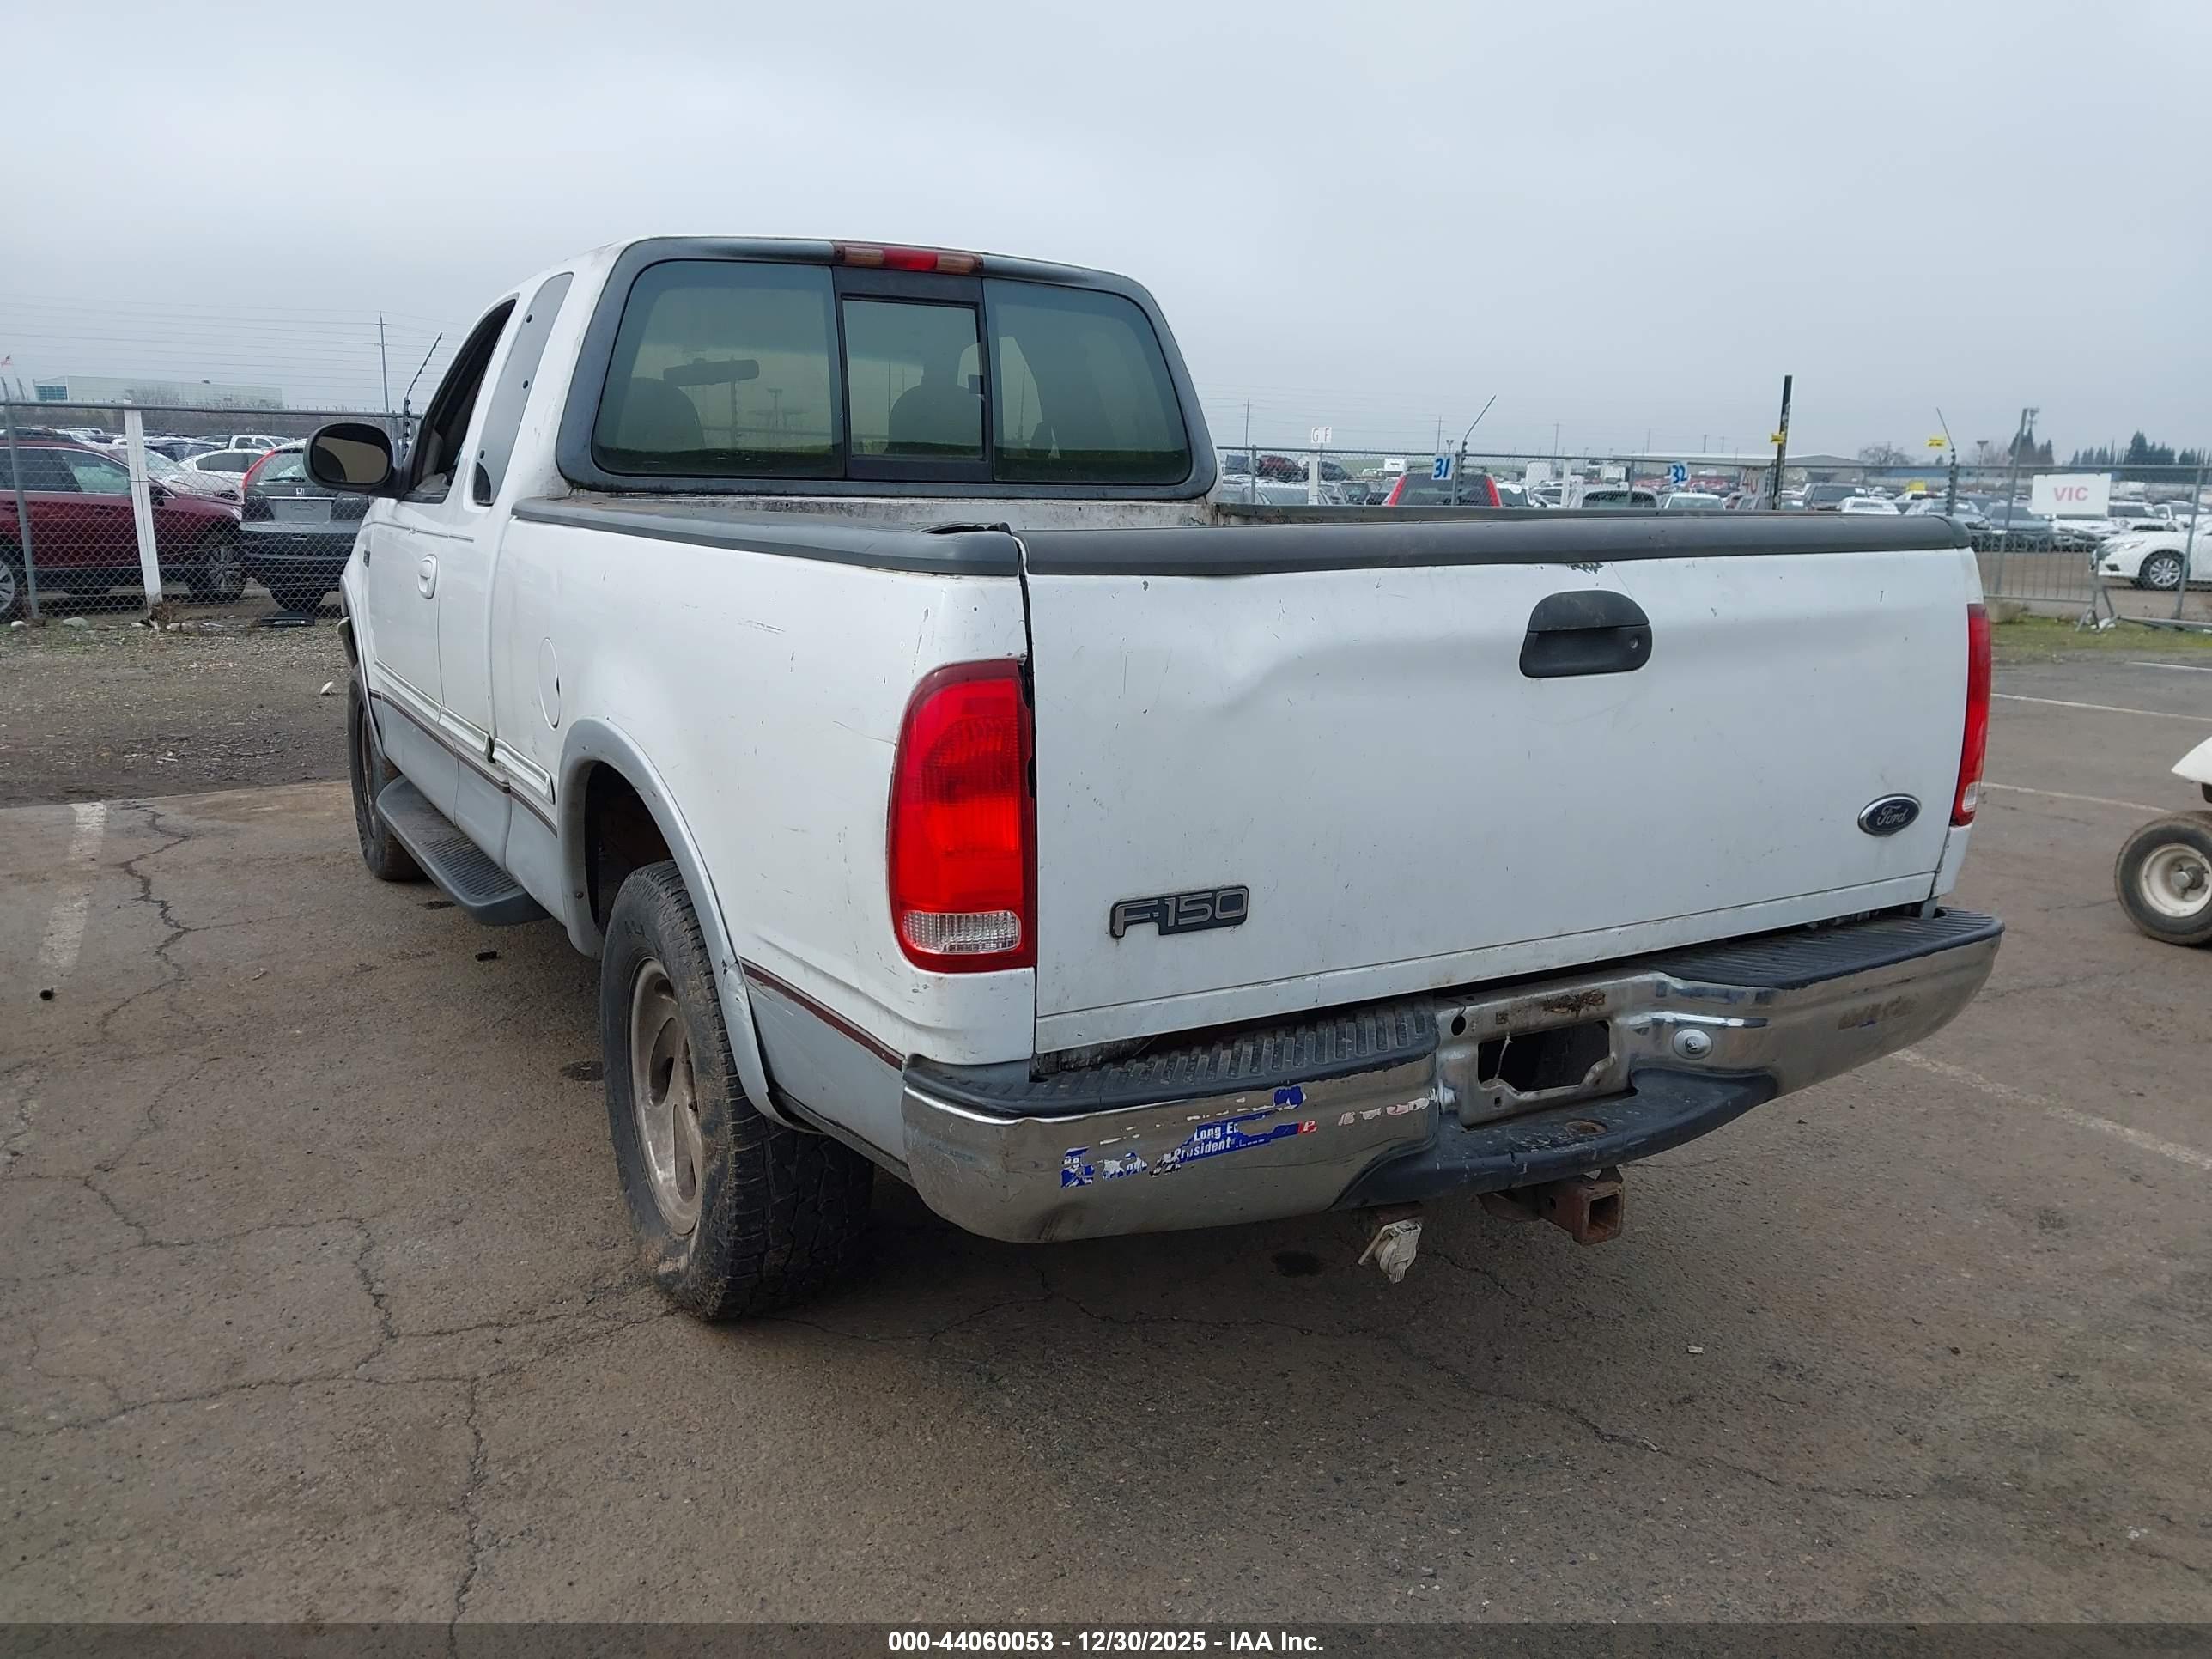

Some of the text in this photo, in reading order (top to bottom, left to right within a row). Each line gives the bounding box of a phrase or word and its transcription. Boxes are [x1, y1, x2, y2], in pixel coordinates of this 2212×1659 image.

[1312, 428, 1319, 442] G
[1433, 457, 1451, 478] 31
[1672, 465, 1687, 484] 32
[2053, 486, 2088, 502] VIC
[1877, 805, 1909, 826] Ford
[1113, 887, 1249, 937] F-150
[1194, 1126, 1222, 1143] Long
